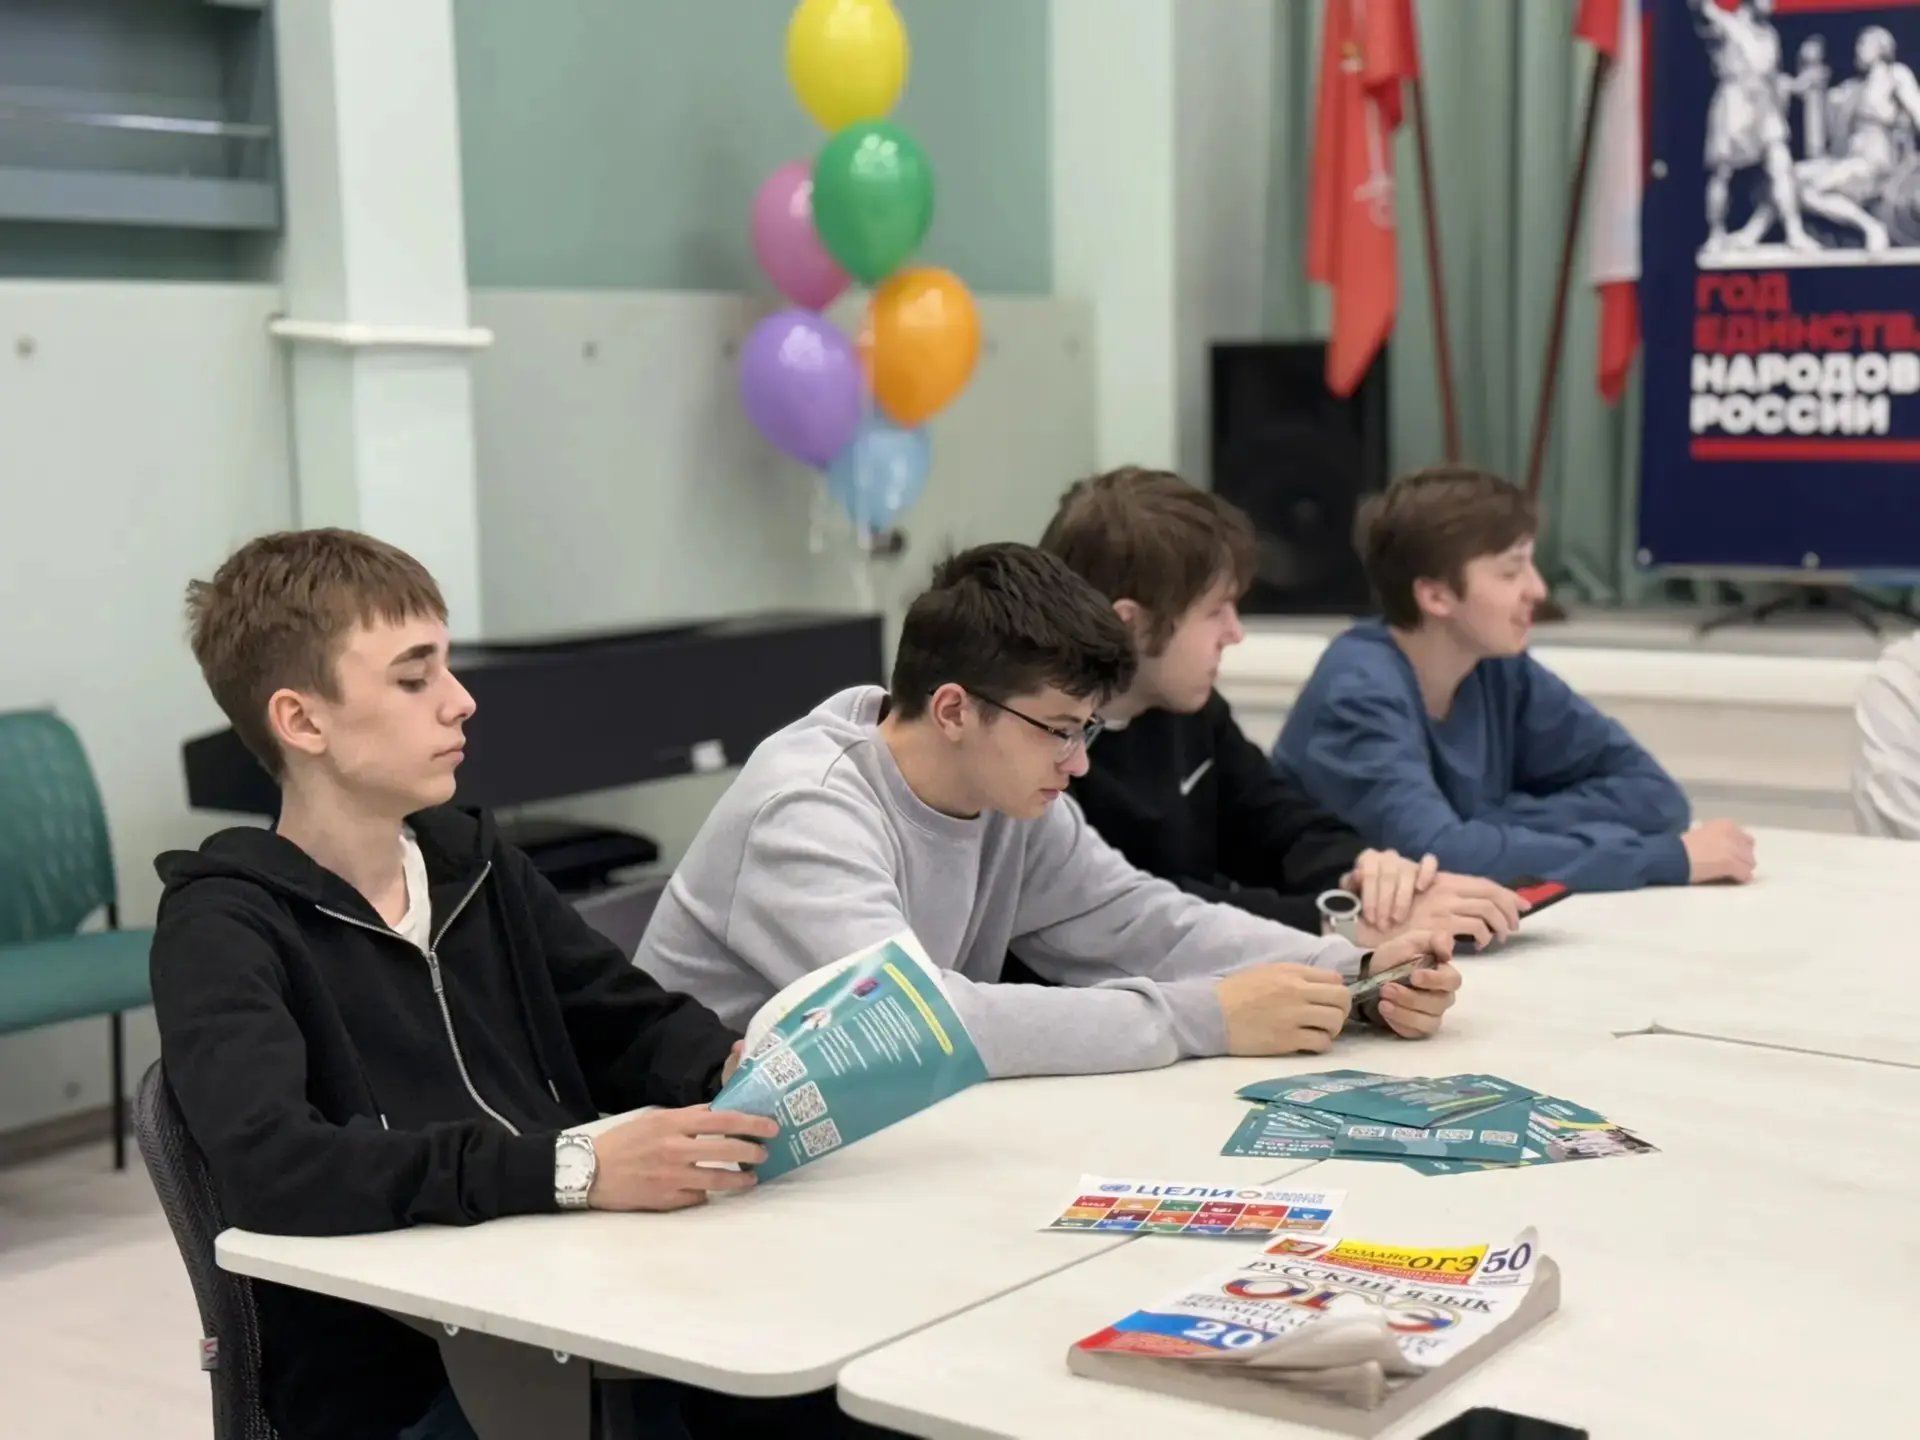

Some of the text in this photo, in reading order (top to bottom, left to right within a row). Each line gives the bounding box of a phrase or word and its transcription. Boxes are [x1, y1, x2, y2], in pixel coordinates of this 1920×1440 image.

[1696, 273, 1789, 311] ГОД
[1694, 311, 1920, 354] ЕДИНСТВ
[1691, 352, 1920, 395] НАРОДОВ
[1690, 393, 1891, 435] РОССИИ
[1136, 1184, 1234, 1199] ЦЕЛИ
[1408, 1255, 1479, 1273] ОГЭ
[1482, 1242, 1531, 1273] 50
[1240, 1261, 1397, 1293] РУССКИЙ
[1402, 1289, 1498, 1313] ЯЗЫК
